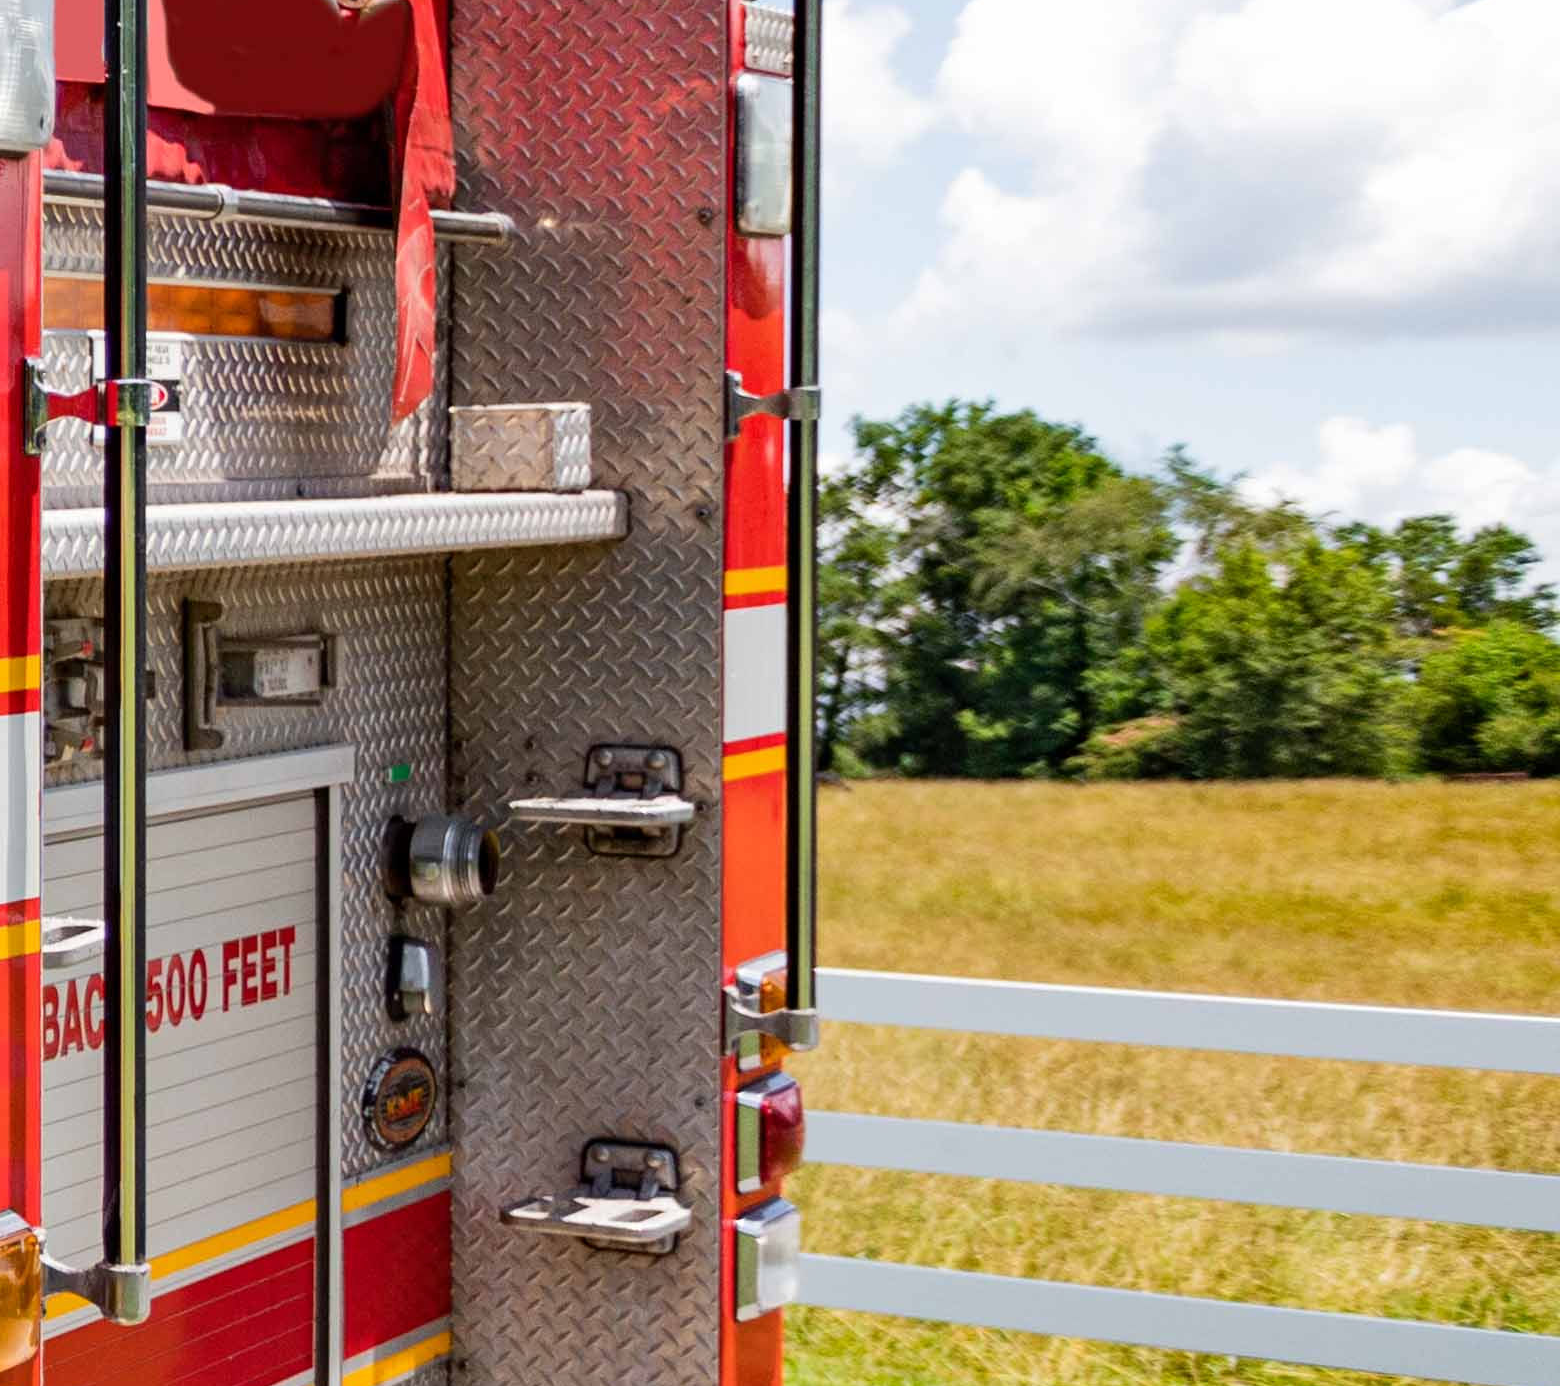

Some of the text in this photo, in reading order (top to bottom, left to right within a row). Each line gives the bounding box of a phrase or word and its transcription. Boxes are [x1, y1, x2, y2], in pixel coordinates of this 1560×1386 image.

[42, 924, 296, 1062] BAC 500 FEET
